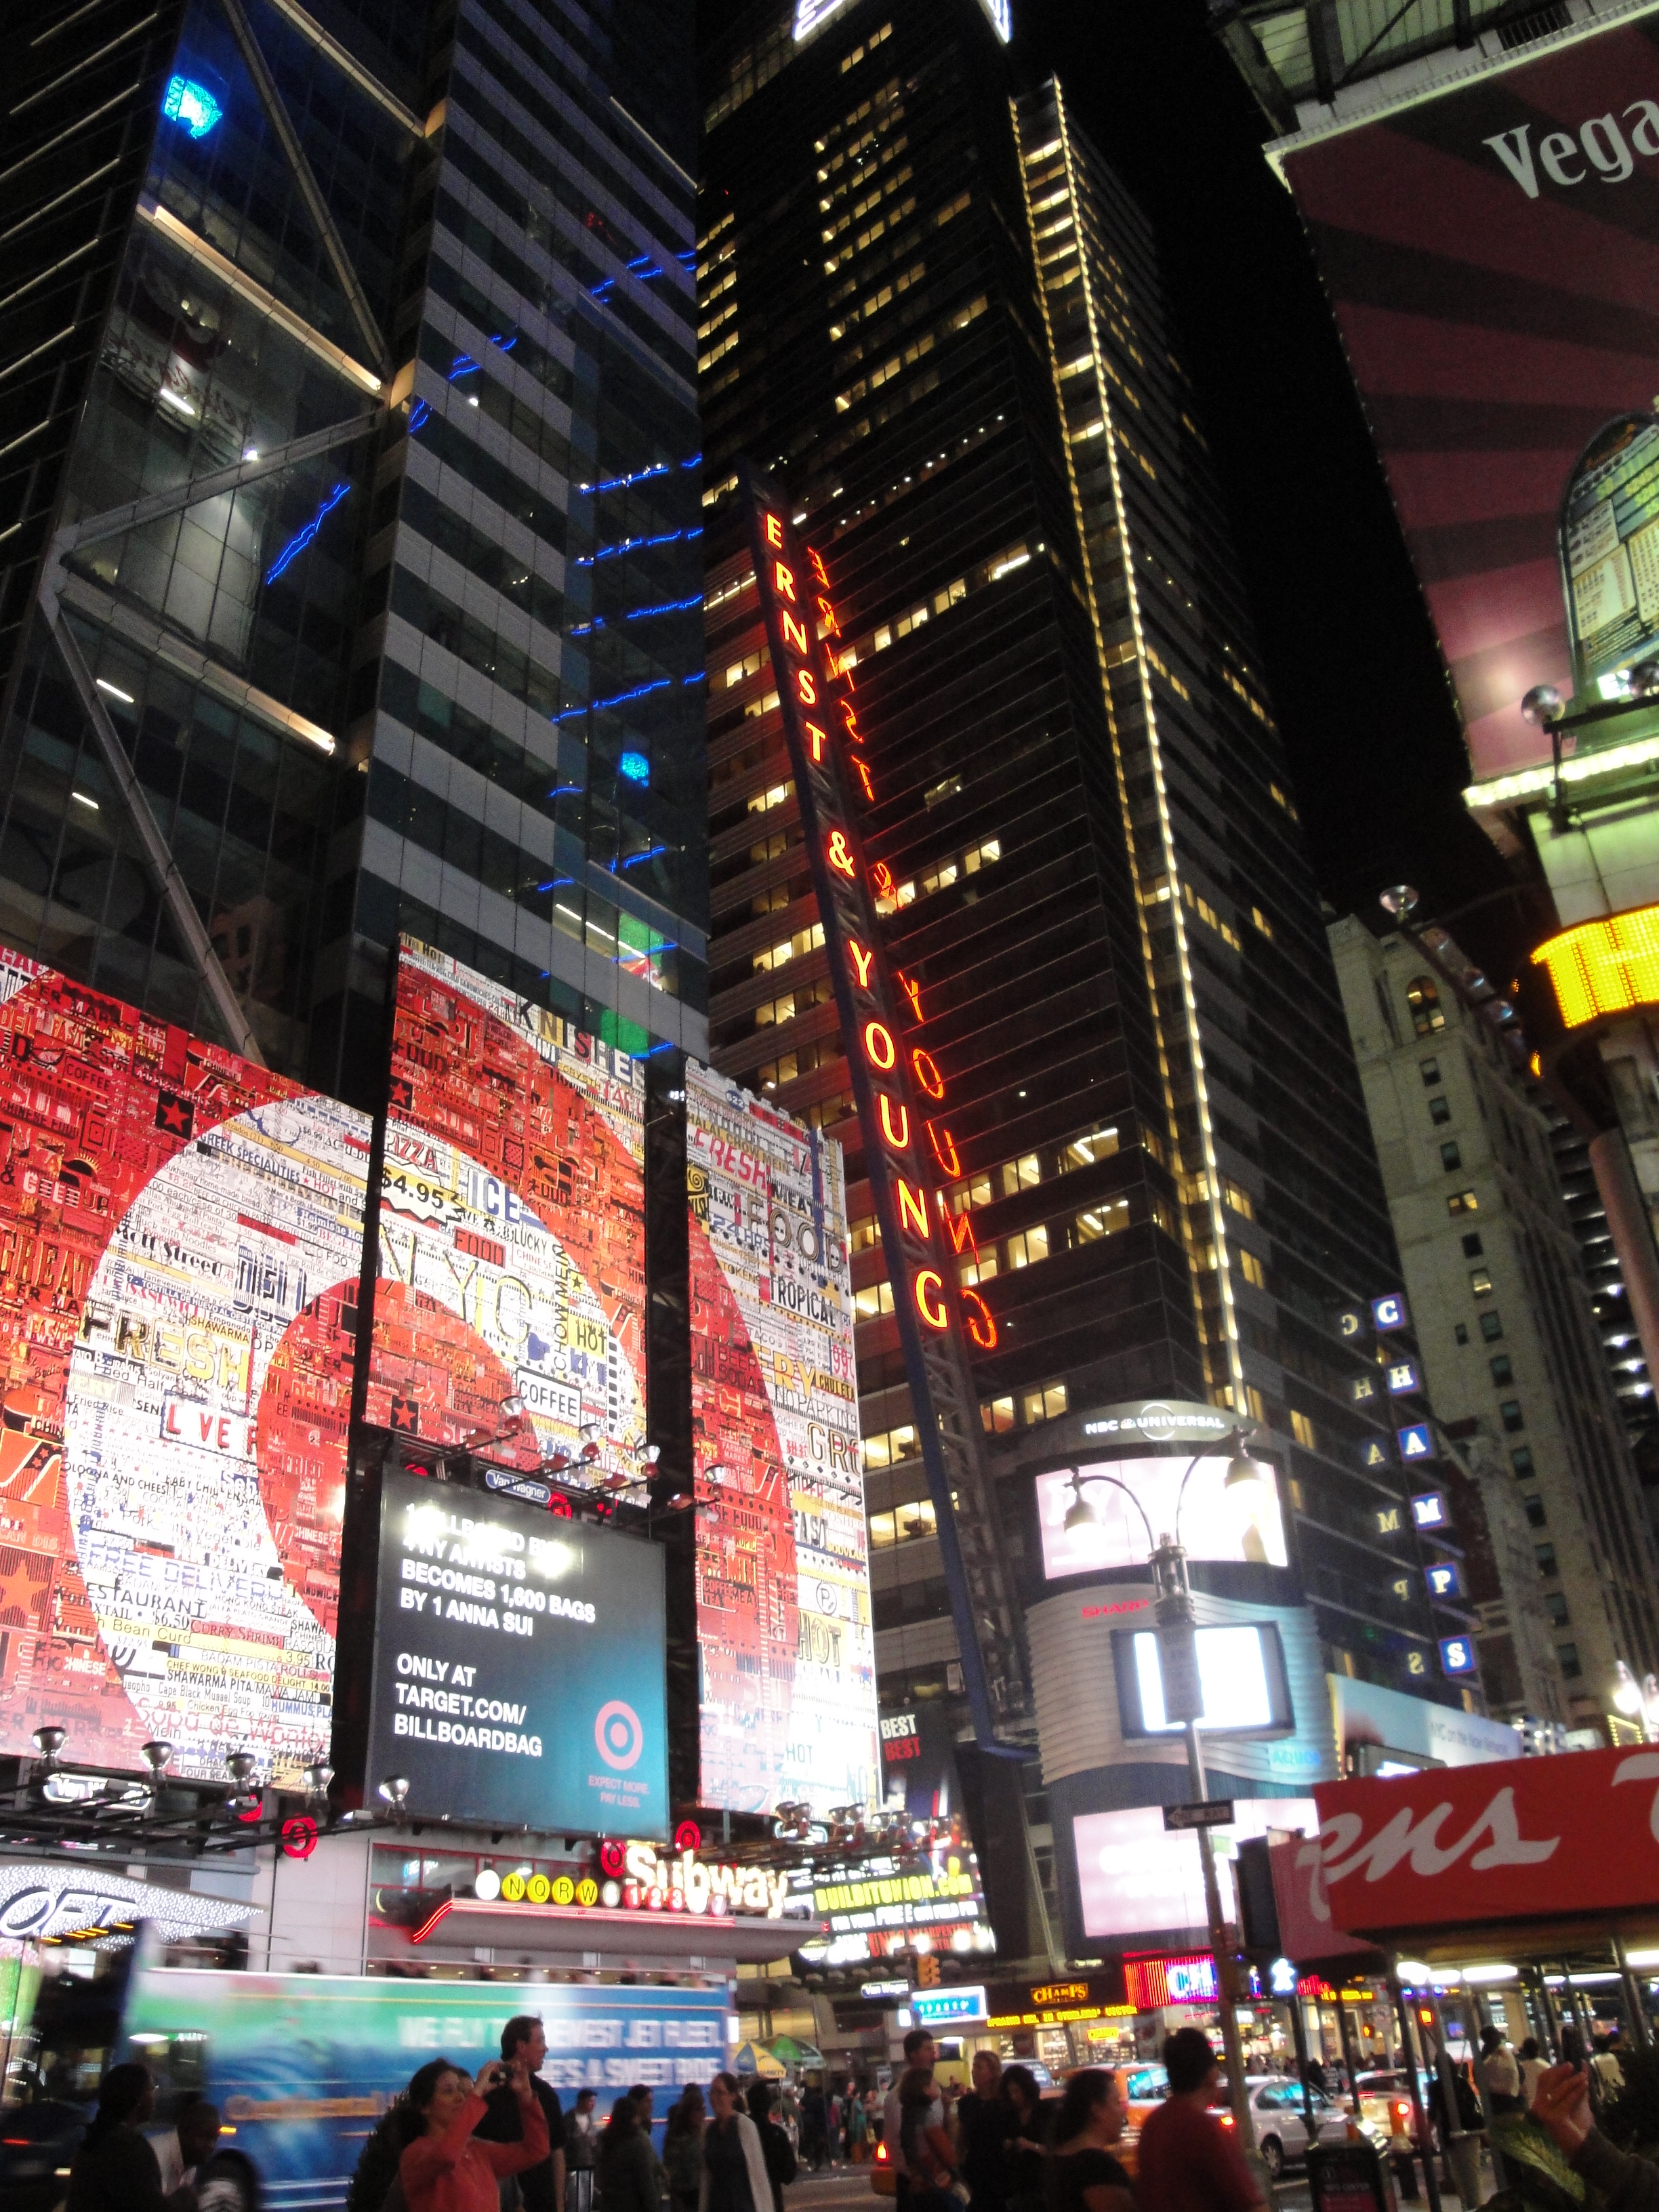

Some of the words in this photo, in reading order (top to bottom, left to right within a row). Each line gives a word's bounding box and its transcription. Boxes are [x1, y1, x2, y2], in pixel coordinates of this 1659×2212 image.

[765, 512, 826, 762] ERNST
[829, 830, 855, 878] &
[848, 939, 948, 1330] YOUNG
[66, 1063, 112, 1092] COFFEE
[302, 1126, 323, 1141] $6.99
[726, 1131, 758, 1158] CHOW
[201, 1131, 234, 1153] GREEK
[237, 1147, 300, 1184] SPECIALITIES
[693, 1127, 771, 1191] FRESH
[199, 1176, 239, 1200] home-made
[302, 1166, 316, 1181] Fish
[319, 1172, 337, 1187] Fillet
[314, 1179, 336, 1197] HOT
[381, 1166, 445, 1210] $4.95
[167, 1186, 213, 1212] each/case
[194, 1186, 210, 1199] BEEF
[222, 1199, 251, 1217] CHICKEN
[340, 1191, 358, 1207] and
[467, 1166, 521, 1225] ICE
[147, 1198, 165, 1212] Pork
[200, 1218, 223, 1236] (each)
[200, 1210, 226, 1227] (Punta)
[297, 1216, 318, 1233] $1.99
[182, 1233, 217, 1254] Noodles
[514, 1227, 548, 1255] LUCKY
[712, 1213, 741, 1237] 24
[745, 1230, 771, 1250] HRS
[746, 1192, 845, 1275] FOOD
[160, 1242, 222, 1277] Street
[326, 1251, 348, 1267] FOO
[455, 1228, 505, 1267] FOOD
[516, 1249, 554, 1271] CHINESE
[142, 1279, 179, 1300] TORTILLA
[192, 1296, 218, 1313] HUEVO
[378, 1223, 533, 1345] NYC
[770, 1273, 836, 1328] TROPICAL
[191, 1315, 249, 1343] SHAWARMA
[209, 1313, 251, 1334] Empanada
[79, 1299, 250, 1393] FRESH
[554, 1305, 569, 1371] CHOW
[577, 1324, 607, 1355] HOT
[138, 1376, 165, 1392] Half
[518, 1379, 577, 1418] COFFEE
[775, 1383, 796, 1408] NO
[798, 1391, 858, 1430] PARKING
[1085, 1418, 1119, 1435] NBC
[1136, 1415, 1225, 1429] UNIVERSAL
[722, 1441, 751, 1456] FARMERS
[724, 1450, 749, 1465] MARKET
[112, 1473, 135, 1486] AND
[492, 1473, 513, 1488] Van
[512, 1478, 547, 1500] Wagner
[1376, 1303, 1467, 1668] CHAMPS
[401, 1557, 496, 1600] BECOMES
[500, 1583, 546, 1612] 1,600
[549, 1593, 596, 1624] BAGS
[93, 1603, 133, 1620] XTAIL
[215, 1595, 241, 1606] HONG
[243, 1601, 268, 1613] KONG
[270, 1605, 298, 1619] STEAK
[259, 1613, 289, 1626] GRANDE
[400, 1586, 428, 1612] BY
[432, 1595, 442, 1616] 1
[445, 1599, 499, 1629] ANNA
[503, 1612, 533, 1637] SUI
[1080, 1598, 1149, 1620] SHARP
[113, 1618, 150, 1637] Bean
[157, 1626, 191, 1645] Curd
[798, 1609, 841, 1667] HOT
[201, 1650, 243, 1668] BADAM
[246, 1657, 277, 1672] PISTA
[286, 1651, 310, 1668] 3.95
[396, 1653, 449, 1682] ONLY
[451, 1663, 477, 1689] AT
[167, 1660, 190, 1671] CHEF
[228, 1668, 270, 1683] SEAFOOD
[272, 1675, 306, 1688] DELIGHT
[167, 1668, 227, 1689] SHAWARMA
[230, 1678, 254, 1693] PITA
[158, 1681, 177, 1697] Cape
[180, 1685, 201, 1700] Black
[204, 1688, 230, 1703] Mussel
[233, 1689, 251, 1706] Soup
[187, 1700, 220, 1713] Chicken
[395, 1681, 528, 1726] TARGET.COM/
[271, 1699, 314, 1716] HUMMUS
[147, 1722, 182, 1739] Mein
[394, 1713, 543, 1759] BILLBOARDBAG
[880, 1714, 918, 1740] BEST
[785, 1742, 813, 1765] HOT
[884, 1736, 922, 1762] BEST
[588, 1774, 622, 1790] EXPECT
[599, 1790, 617, 1804] PAY
[625, 1843, 789, 1919] Subway
[815, 1873, 973, 1912] BUILDITUNION.COM
[1033, 1985, 1087, 2004] CHAMPS
